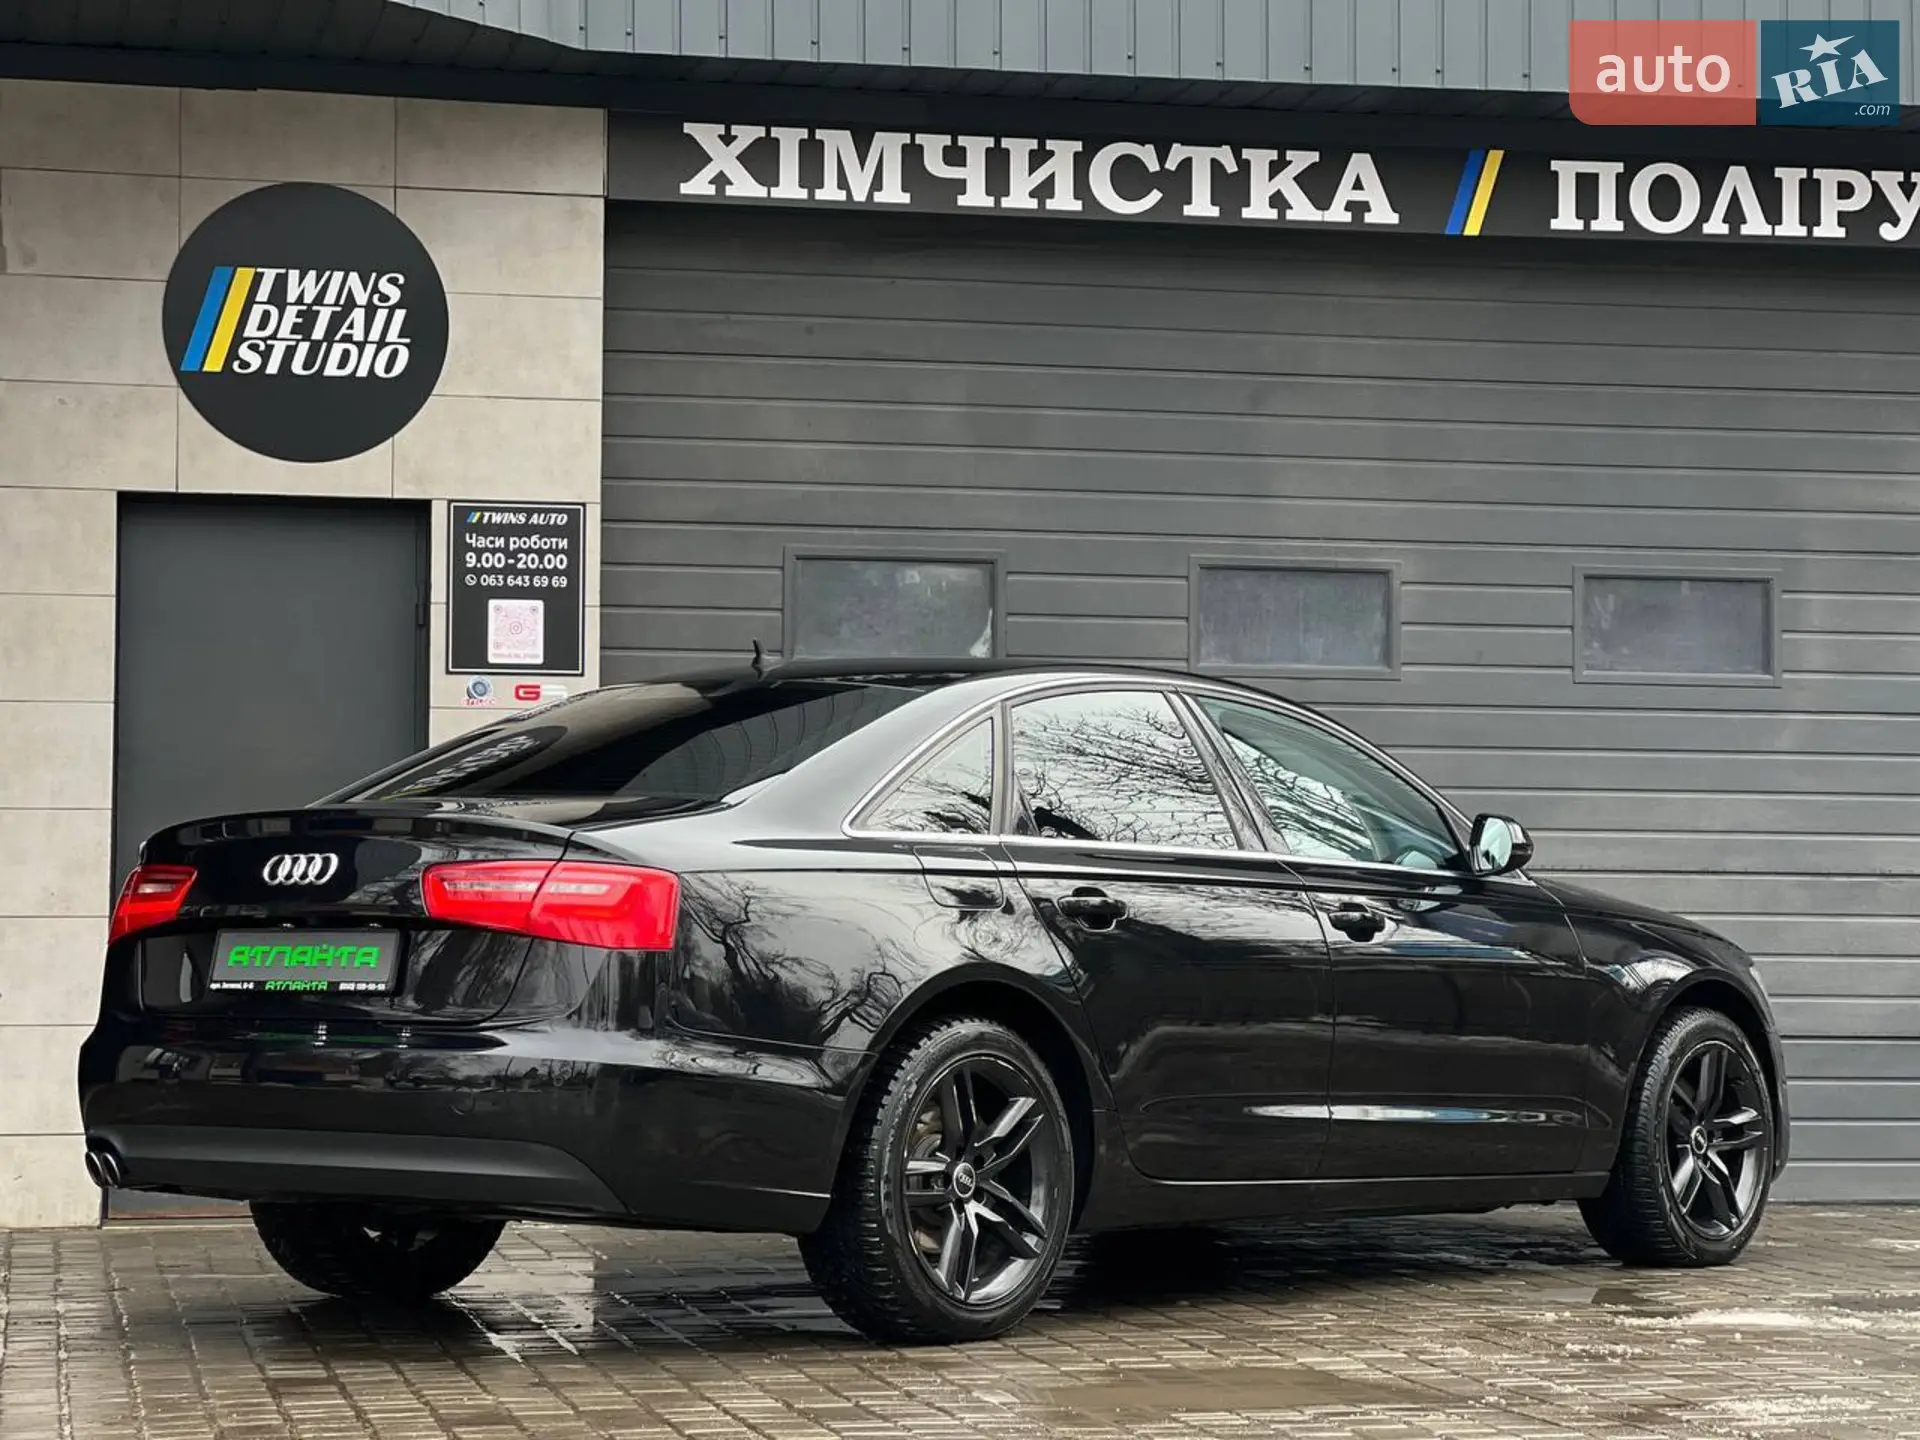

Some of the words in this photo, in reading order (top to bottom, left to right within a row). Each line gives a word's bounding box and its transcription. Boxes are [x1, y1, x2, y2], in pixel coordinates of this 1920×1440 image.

[680, 123, 1399, 224] ХІМЧИСТКА
[255, 268, 405, 305] TWINS
[243, 304, 410, 341] DETAIL
[232, 340, 410, 378] STUDIO
[482, 512, 527, 525] TWINS
[528, 514, 568, 526] AUTO
[465, 533, 505, 548] Часи
[509, 535, 568, 551] роботи
[480, 575, 503, 587] 063
[507, 575, 530, 587] 643
[533, 575, 549, 587] 69
[552, 576, 568, 588] 69
